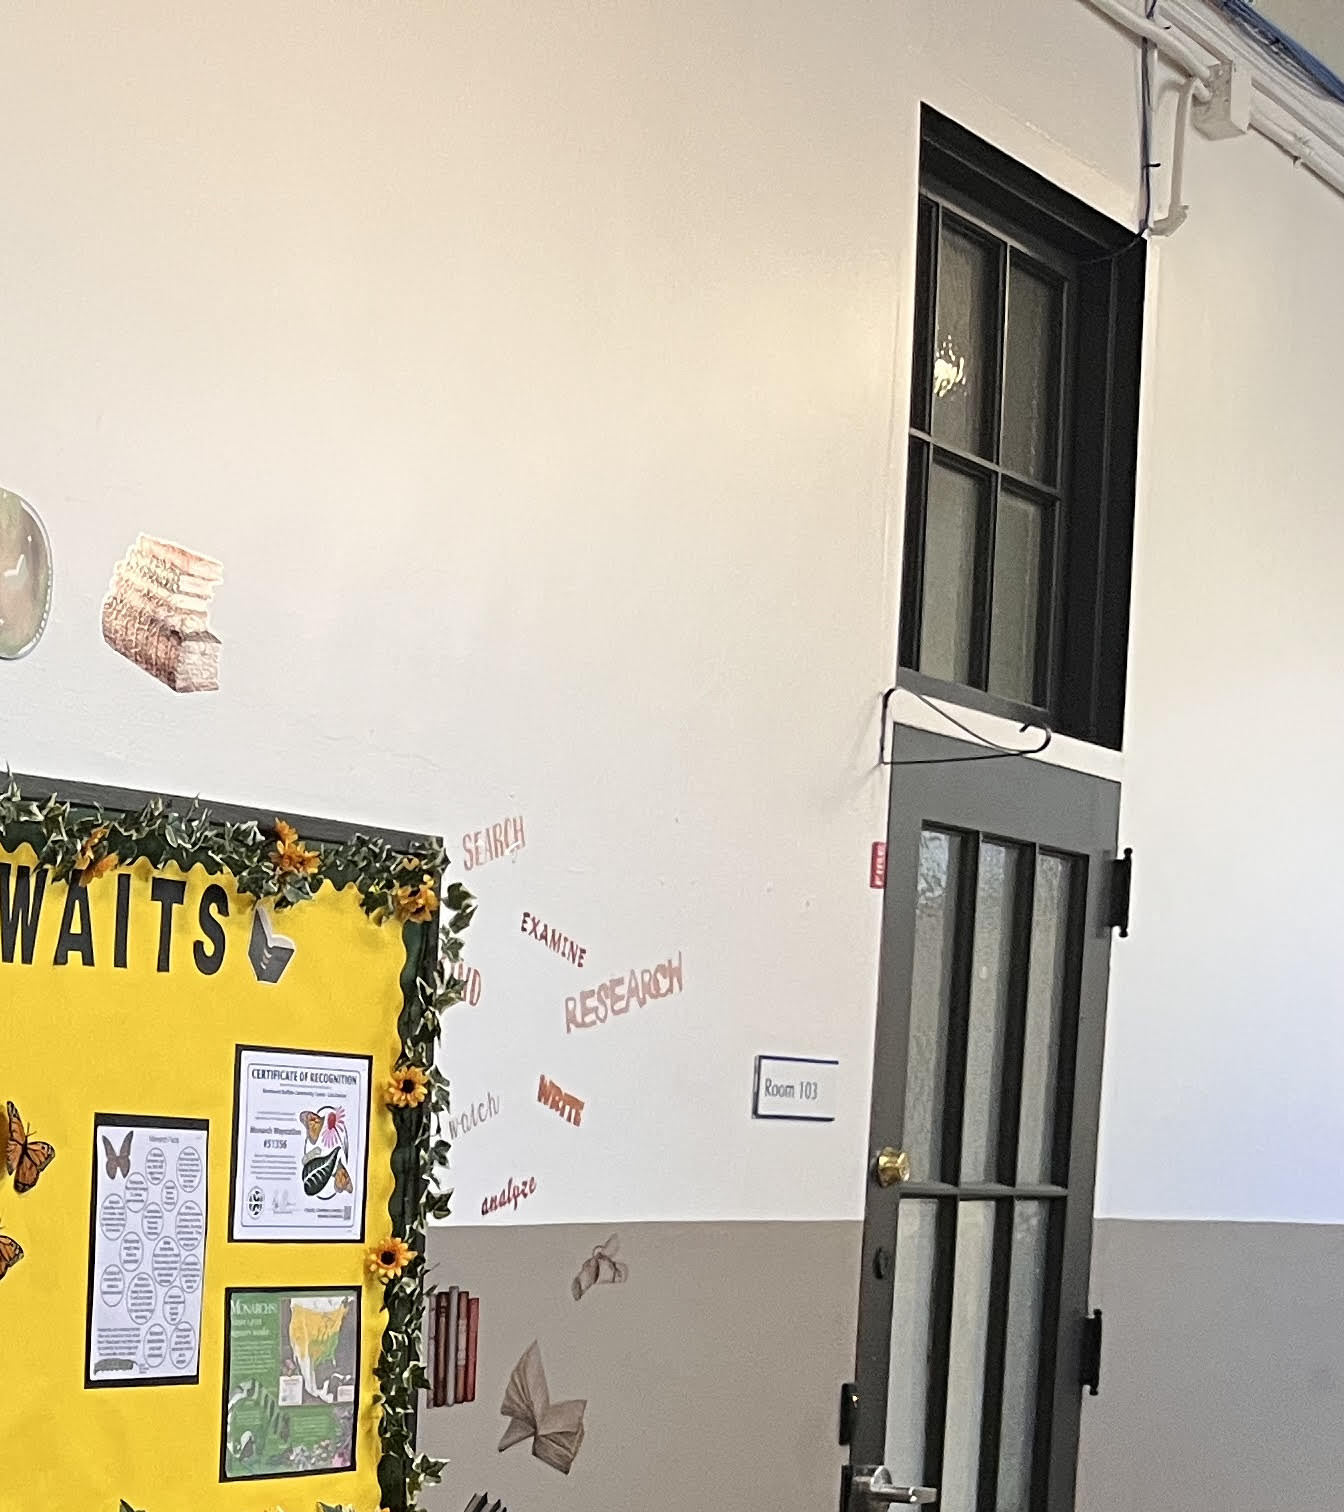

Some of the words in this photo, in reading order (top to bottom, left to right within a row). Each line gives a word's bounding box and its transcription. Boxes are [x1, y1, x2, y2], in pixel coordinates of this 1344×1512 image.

[462, 815, 526, 872] SEARCH
[520, 911, 587, 968] EXAMINE
[565, 950, 683, 1035] RESEARCH
[251, 1068, 298, 1082] CERTIFICATE
[299, 1071, 309, 1082] OF
[310, 1072, 358, 1085] RECOGNITION
[537, 1074, 585, 1127] WRITE
[765, 1078, 795, 1099] Room
[799, 1081, 818, 1100] 103
[449, 1091, 500, 1140] watch
[481, 1176, 538, 1216] analyze
